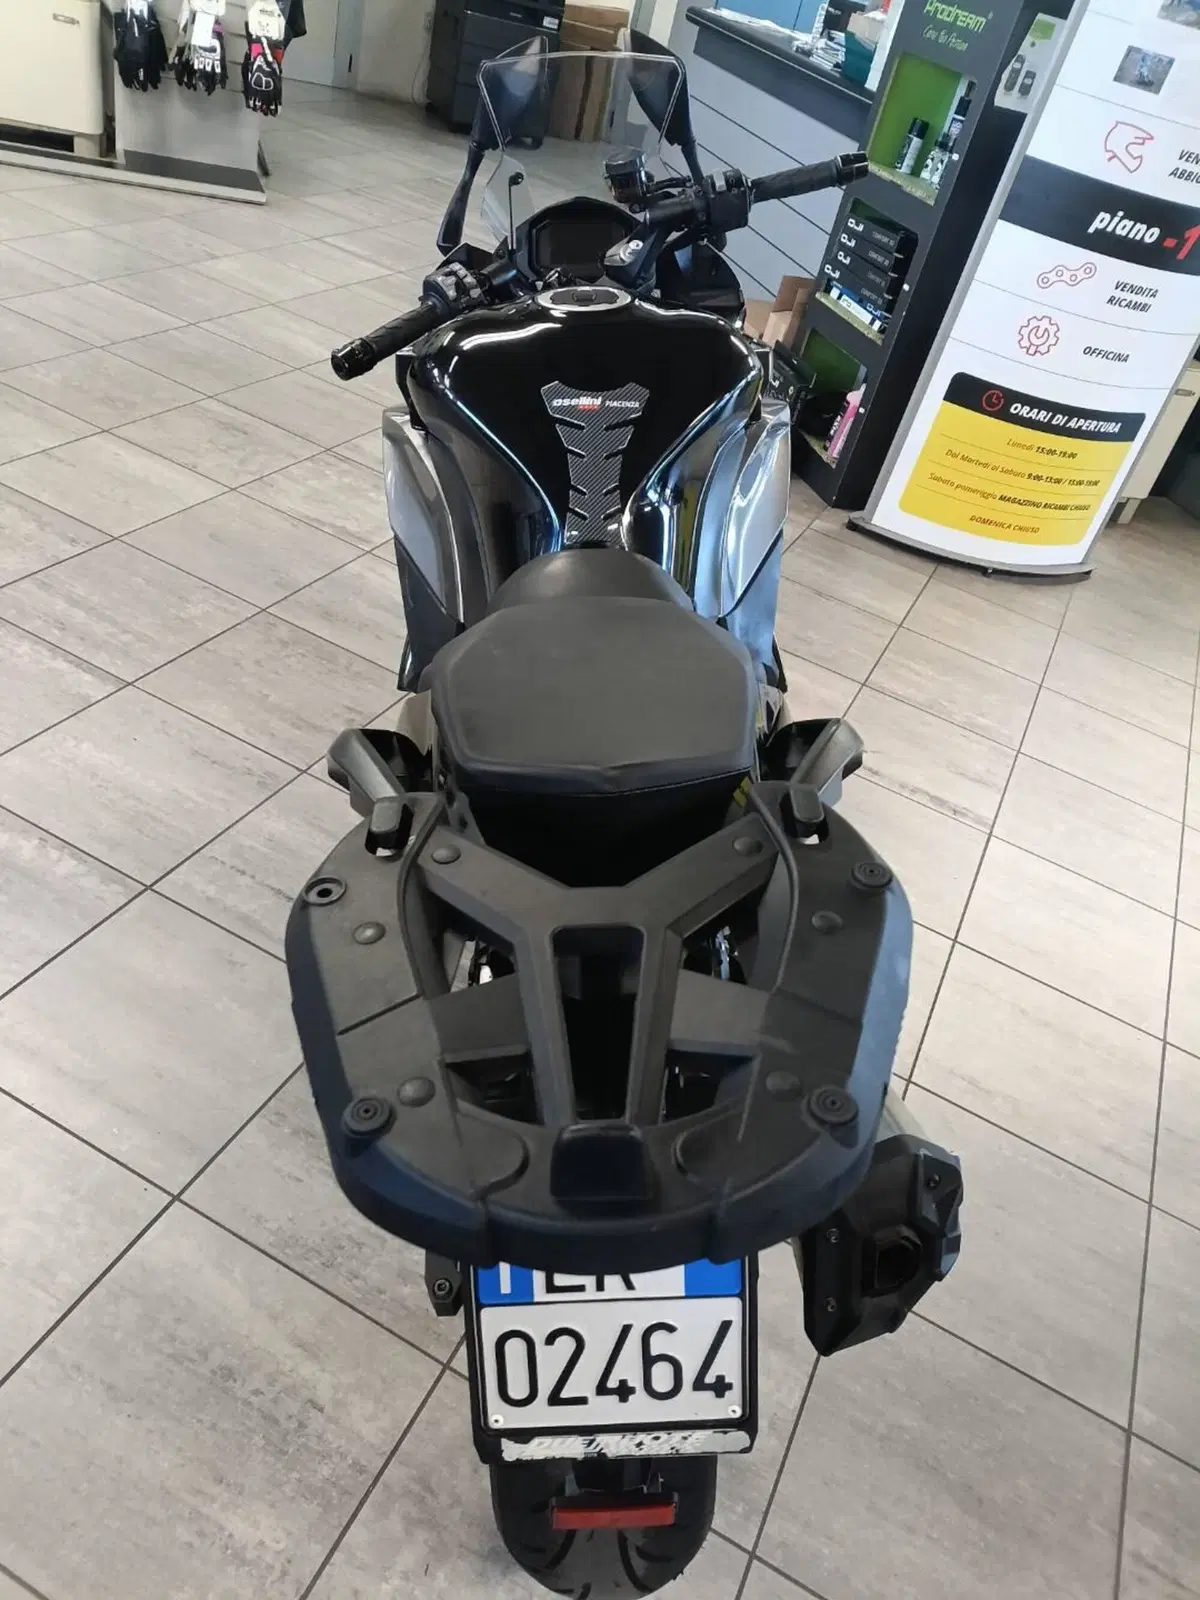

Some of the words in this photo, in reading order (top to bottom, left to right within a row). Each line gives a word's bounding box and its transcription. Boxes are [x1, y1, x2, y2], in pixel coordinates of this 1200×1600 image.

[1178, 149, 1200, 166] VEN
[1087, 211, 1160, 243] piano
[1114, 280, 1159, 299] VENDITA
[1106, 295, 1152, 313] RICAMBI
[1082, 346, 1130, 363] OFFICINA
[605, 400, 640, 408] PIACENZA
[1010, 403, 1052, 423] ORARI
[1051, 414, 1068, 426] DI
[1066, 417, 1121, 433] APERTURA
[999, 466, 1026, 479] Sabato
[928, 473, 955, 487] Sabato
[955, 484, 997, 500] pomeriggio
[998, 494, 1042, 509] MAGAZZINO
[1042, 502, 1070, 511] RICAMBI
[969, 515, 1011, 530] DOMENICA
[1012, 524, 1040, 534] CHIUSO
[494, 1319, 734, 1408] 02464
